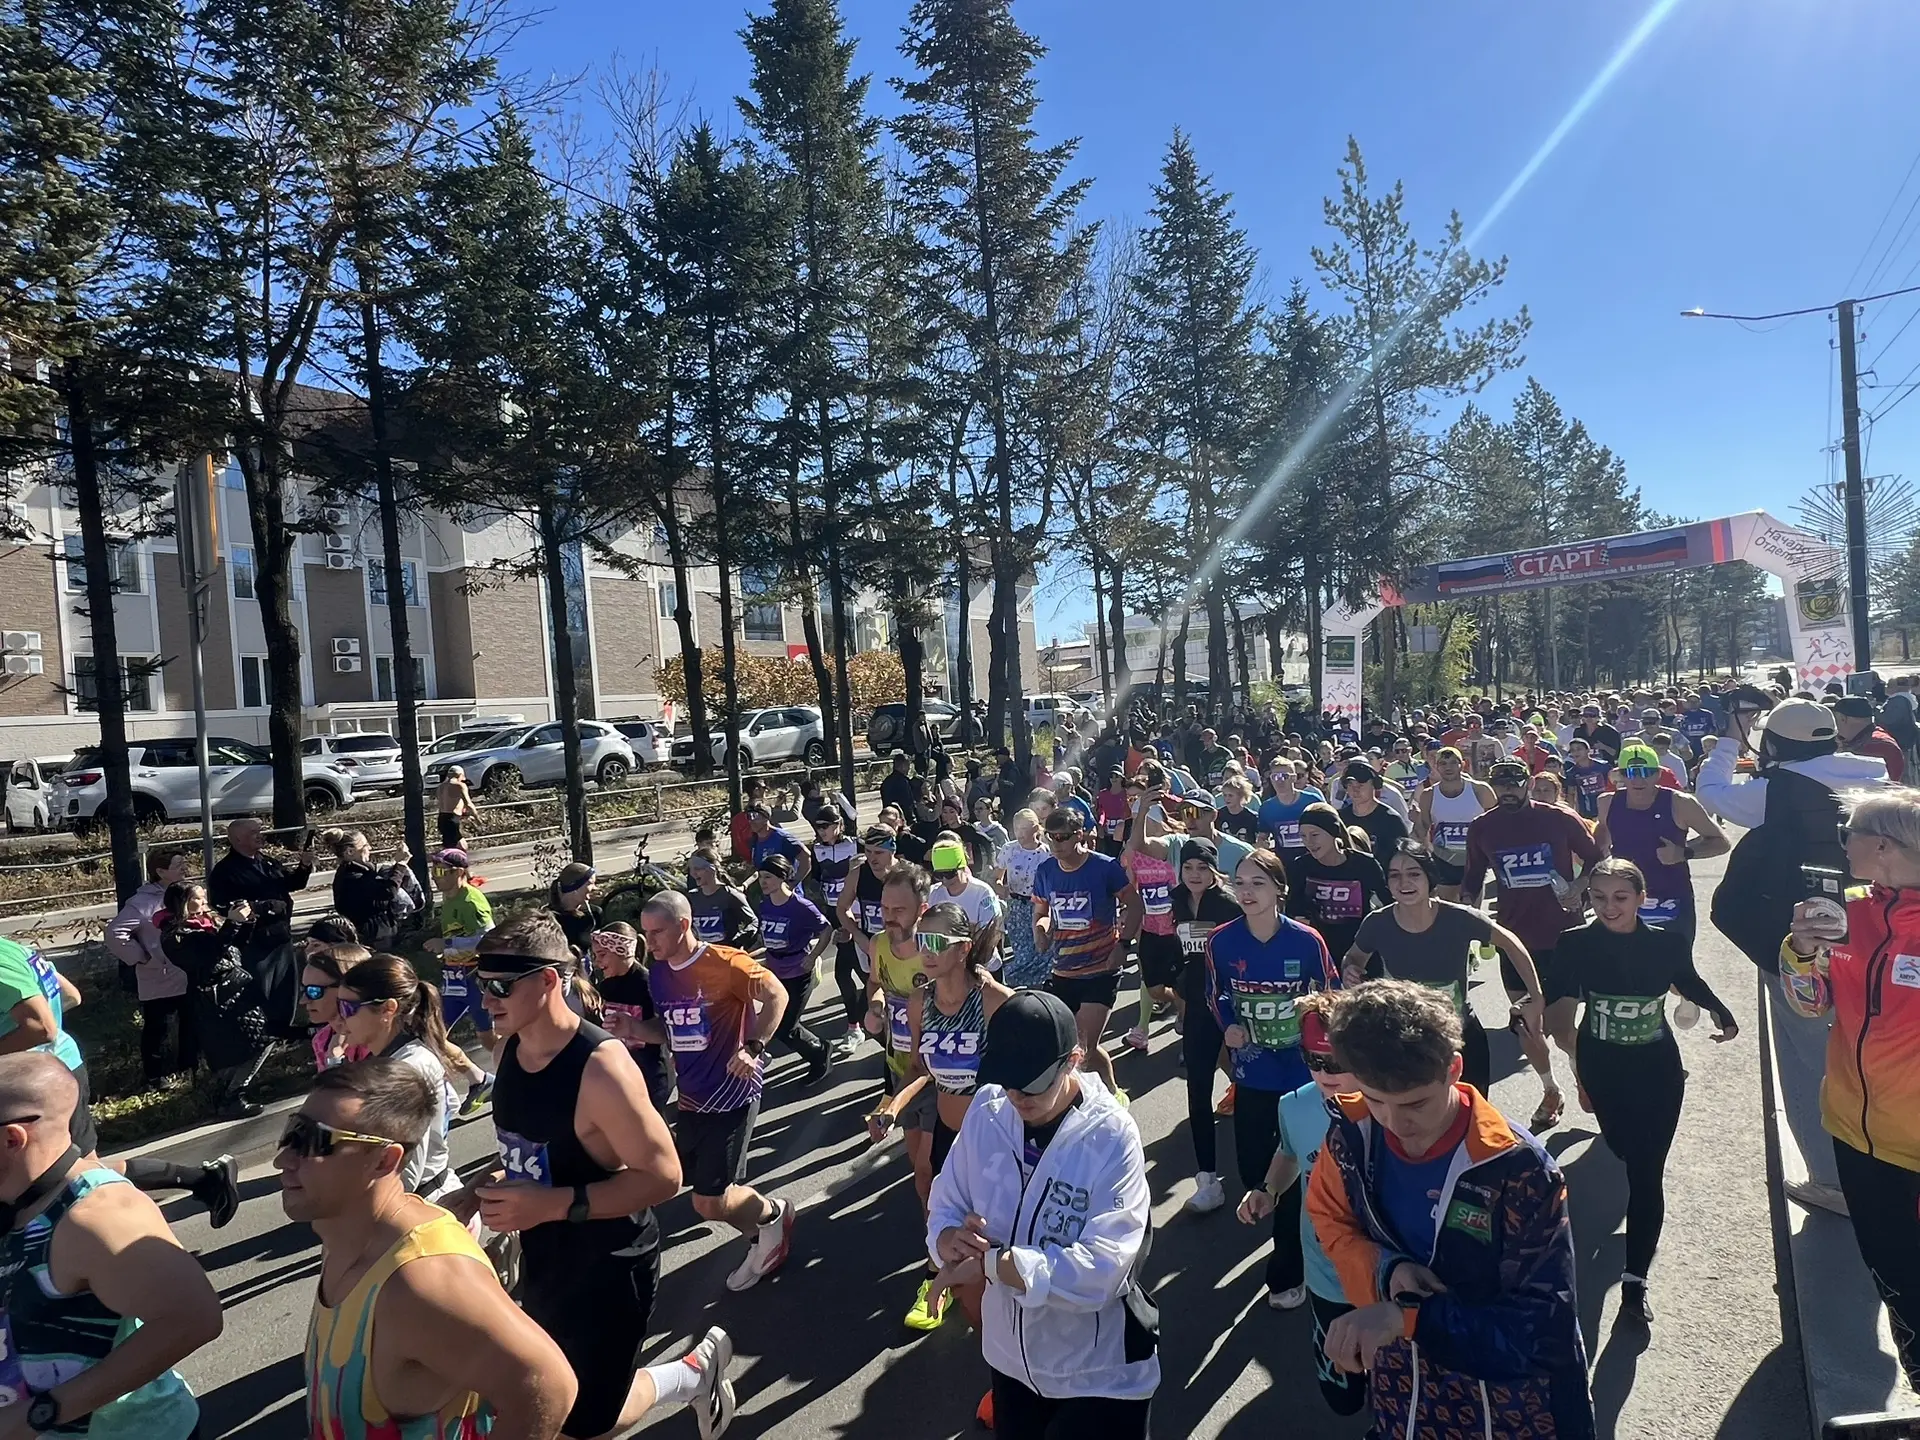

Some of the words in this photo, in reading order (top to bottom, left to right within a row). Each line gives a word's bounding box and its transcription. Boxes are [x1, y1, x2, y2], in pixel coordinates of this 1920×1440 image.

[1519, 549, 1595, 576] СТАРТ
[1043, 652, 1056, 662] 20
[1502, 851, 1545, 869] 211
[1142, 886, 1169, 899] 176
[1315, 885, 1350, 901] 30
[1053, 897, 1089, 911] 217
[693, 916, 720, 928] 377
[760, 920, 787, 934] 375
[663, 1006, 702, 1026] 163
[1240, 1000, 1296, 1020] 102
[1594, 999, 1659, 1020] 104
[919, 1032, 980, 1055] 243
[1457, 1207, 1489, 1228] SFR
